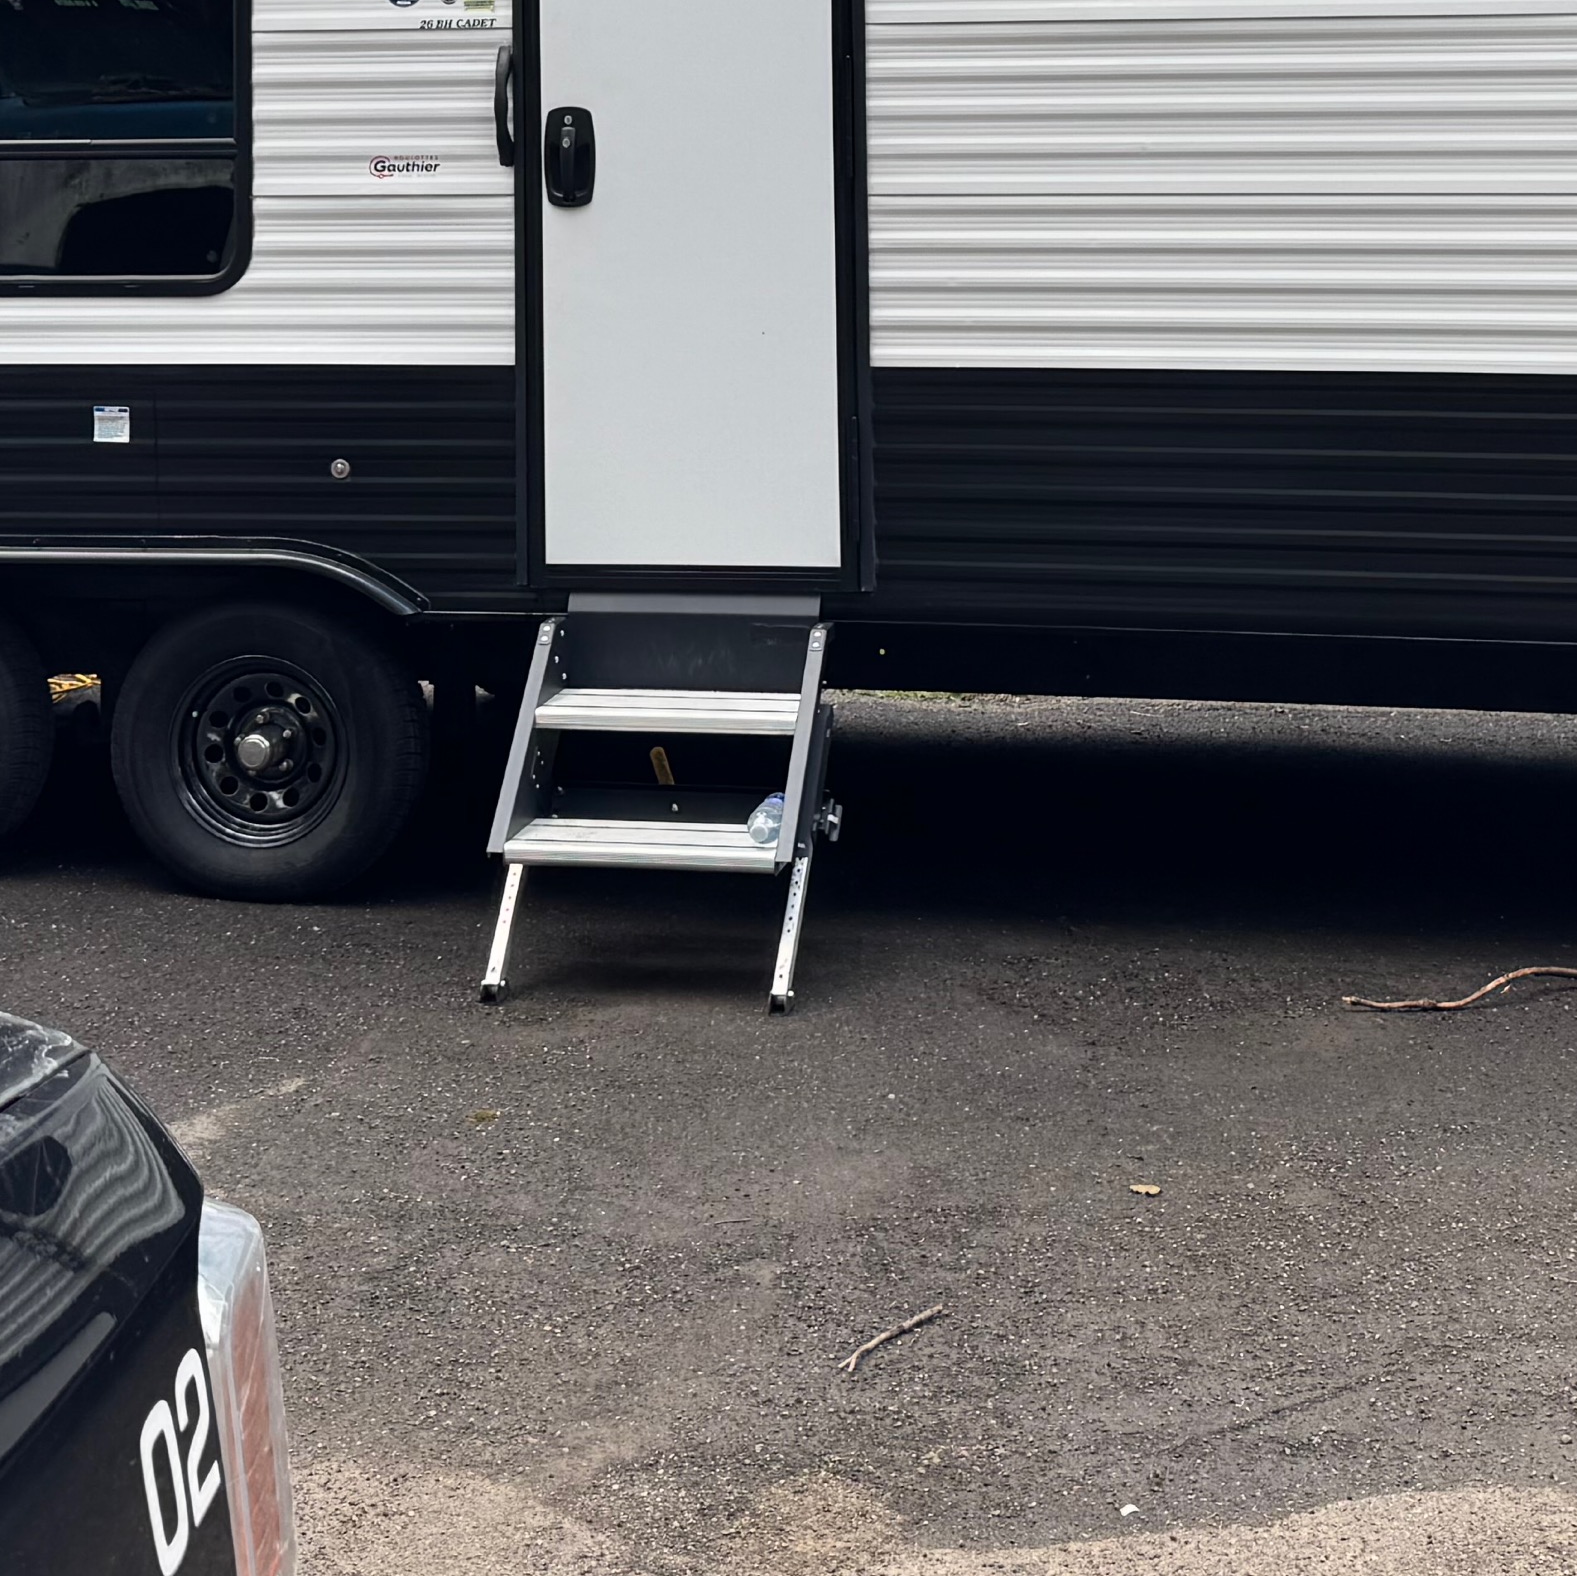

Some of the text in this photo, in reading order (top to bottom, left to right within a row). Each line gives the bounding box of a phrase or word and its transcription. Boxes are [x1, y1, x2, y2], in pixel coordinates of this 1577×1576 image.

[419, 19, 434, 29] 26
[456, 18, 497, 28] CADET
[373, 159, 441, 173] Gauthier
[139, 1347, 222, 1576] 02
